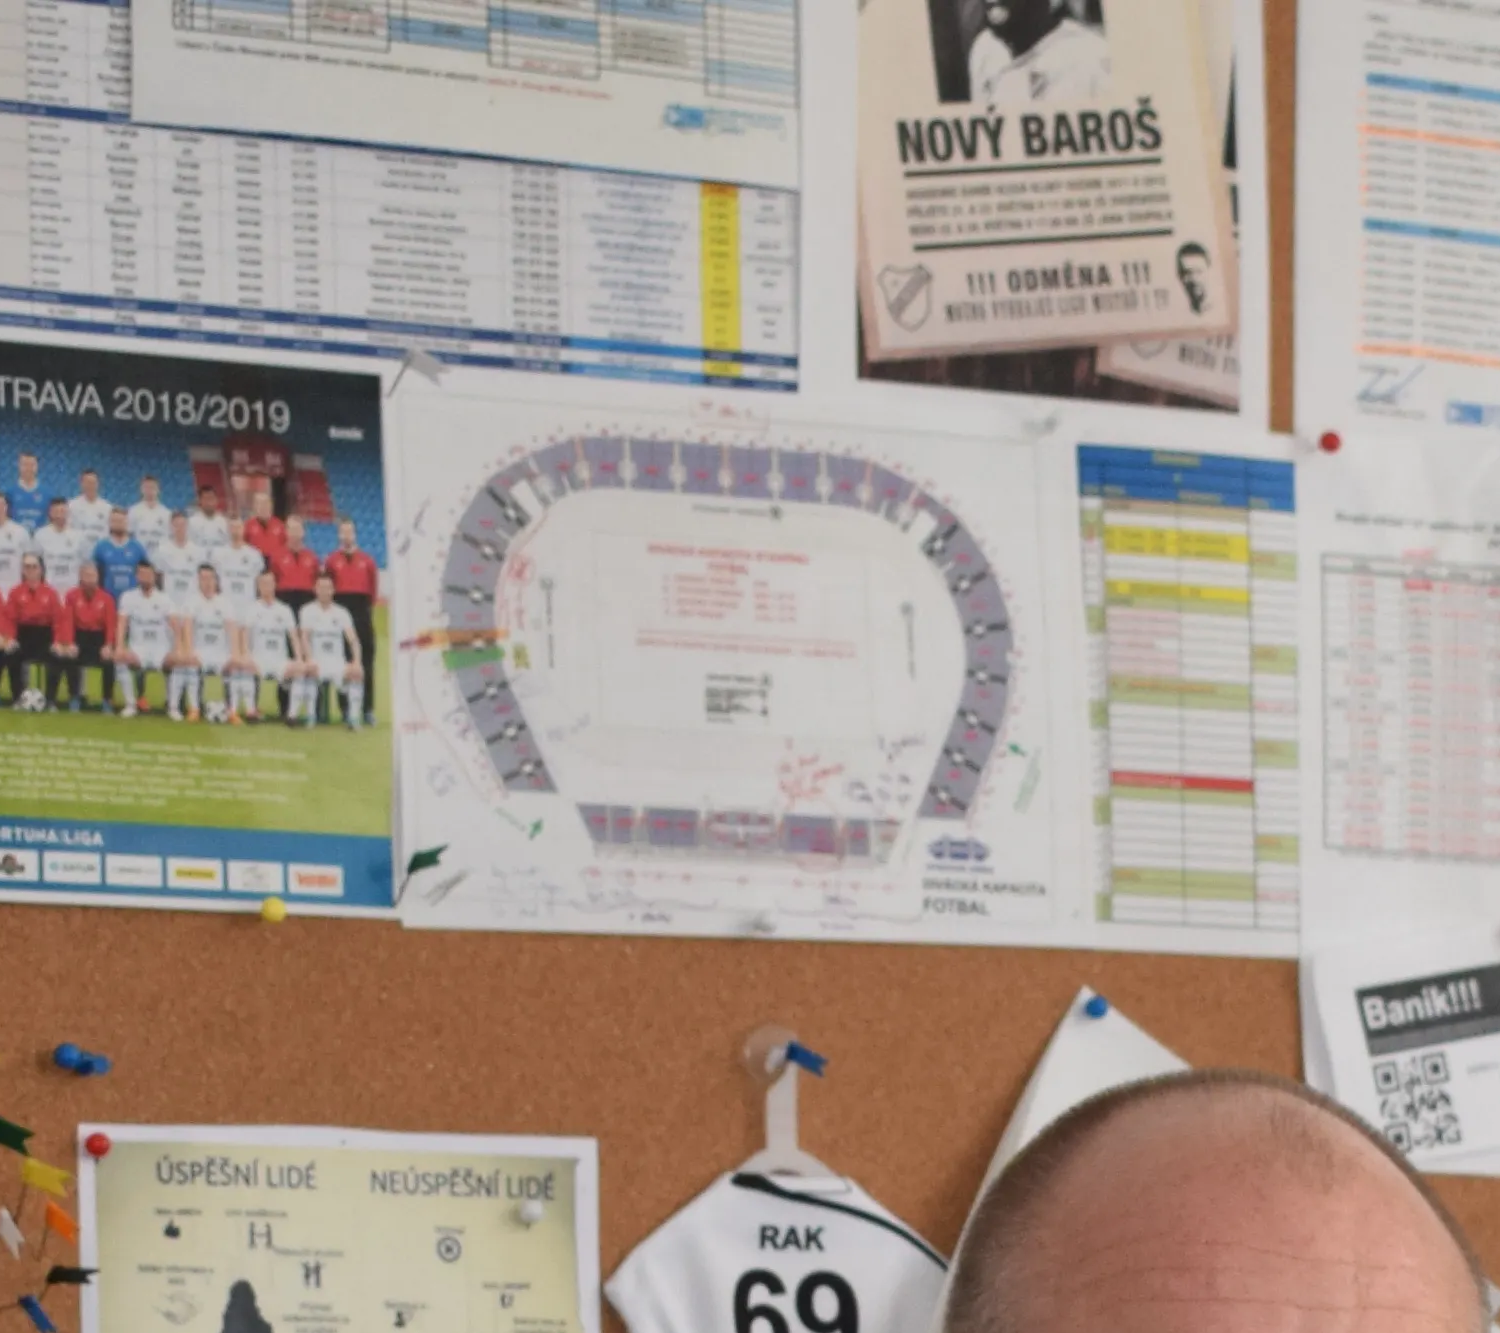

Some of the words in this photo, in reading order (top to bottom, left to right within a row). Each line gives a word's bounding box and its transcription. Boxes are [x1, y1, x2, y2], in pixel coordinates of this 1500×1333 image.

[897, 106, 1003, 163] NOVÝ
[1020, 97, 1162, 156] BAROŠ
[1007, 260, 1113, 293] ODMĚNA
[113, 385, 293, 433] 2018/2019
[923, 897, 991, 916] FOTBAL
[156, 1153, 259, 1188] ÚSPĚŠNÍ
[265, 1159, 318, 1190] LIDÉ
[370, 1166, 500, 1198] NEÚSPĚŠNÍ
[506, 1170, 556, 1201] LIDÉ
[759, 1224, 825, 1251] RAK
